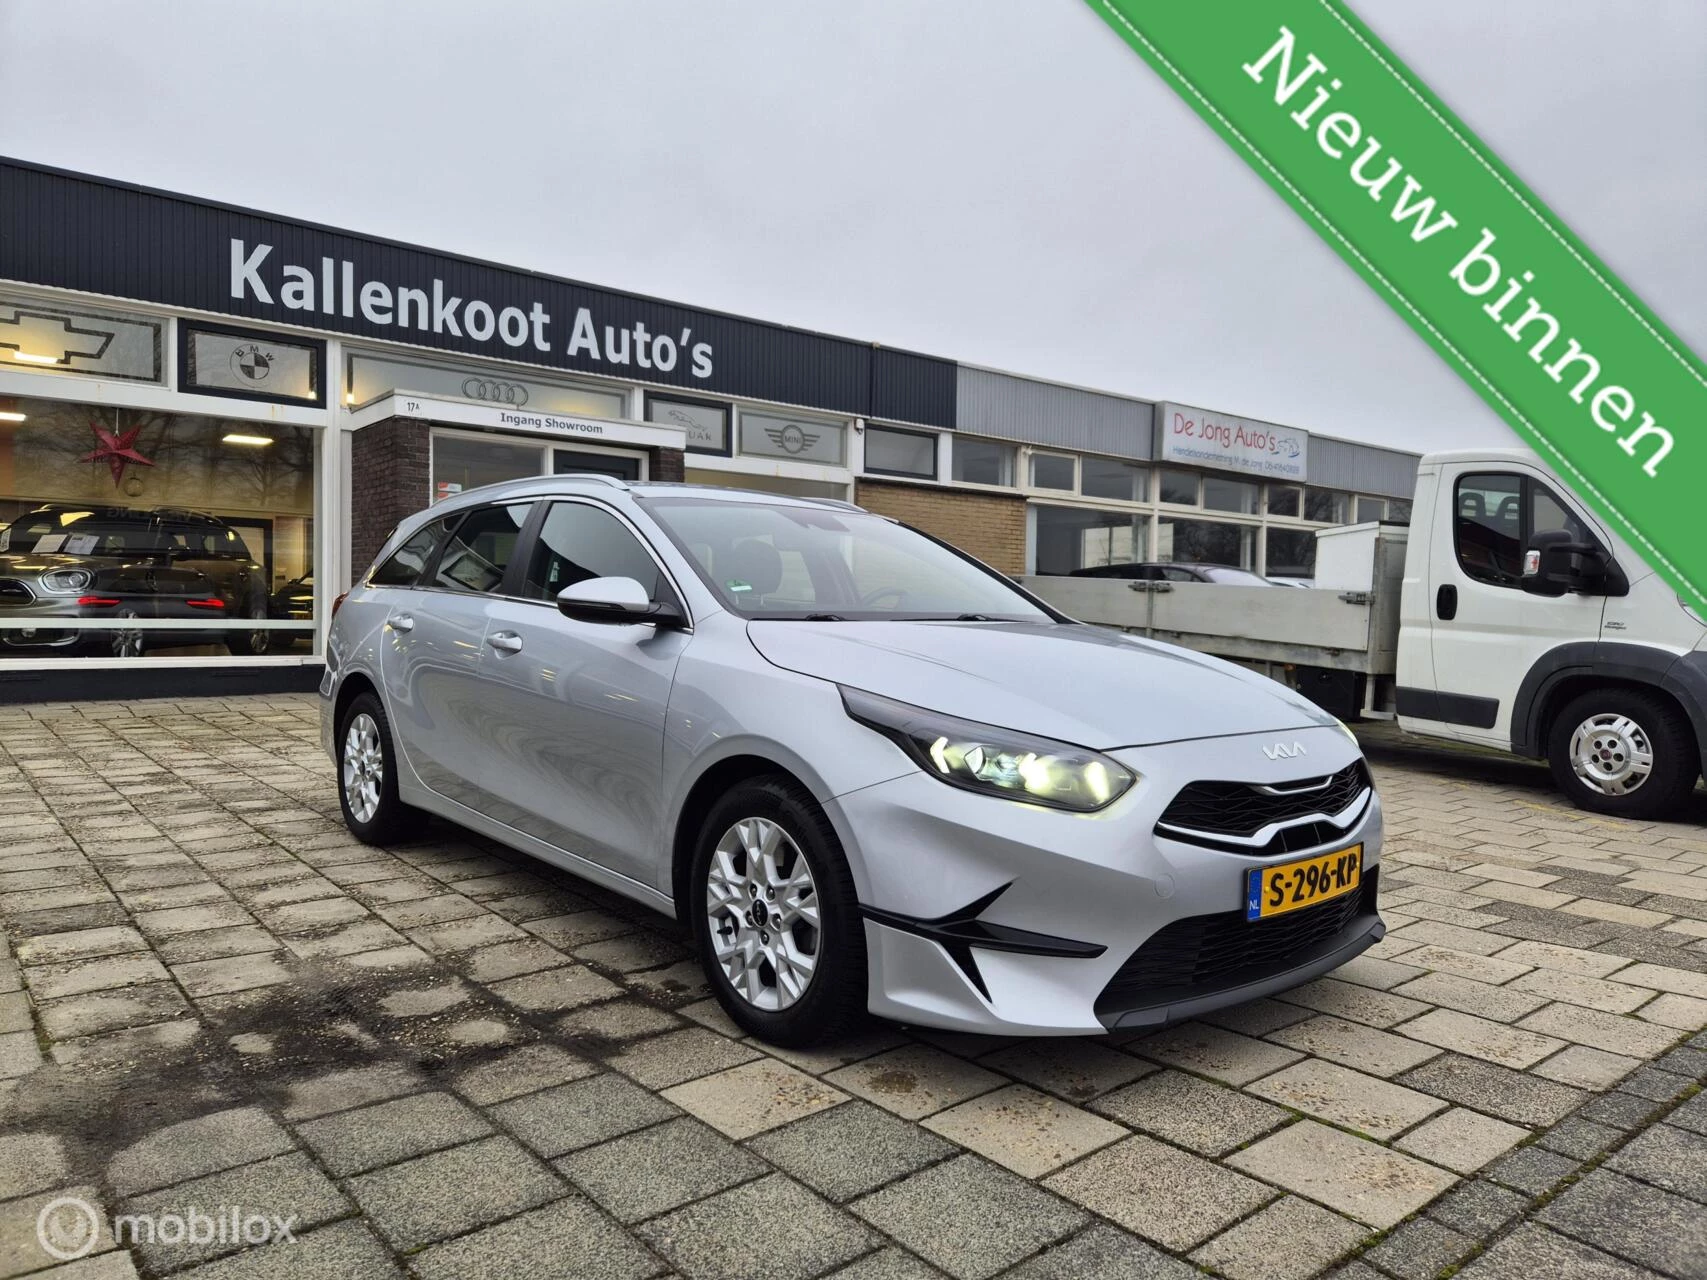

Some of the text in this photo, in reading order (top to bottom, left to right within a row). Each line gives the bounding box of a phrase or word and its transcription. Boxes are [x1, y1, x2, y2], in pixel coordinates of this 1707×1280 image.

[230, 238, 713, 378] Kallenkoot Auto's
[501, 412, 603, 434] Ingang Showroom
[1174, 412, 1276, 452] De Jong Auto's
[1249, 852, 1358, 911] NL S-296-KP
